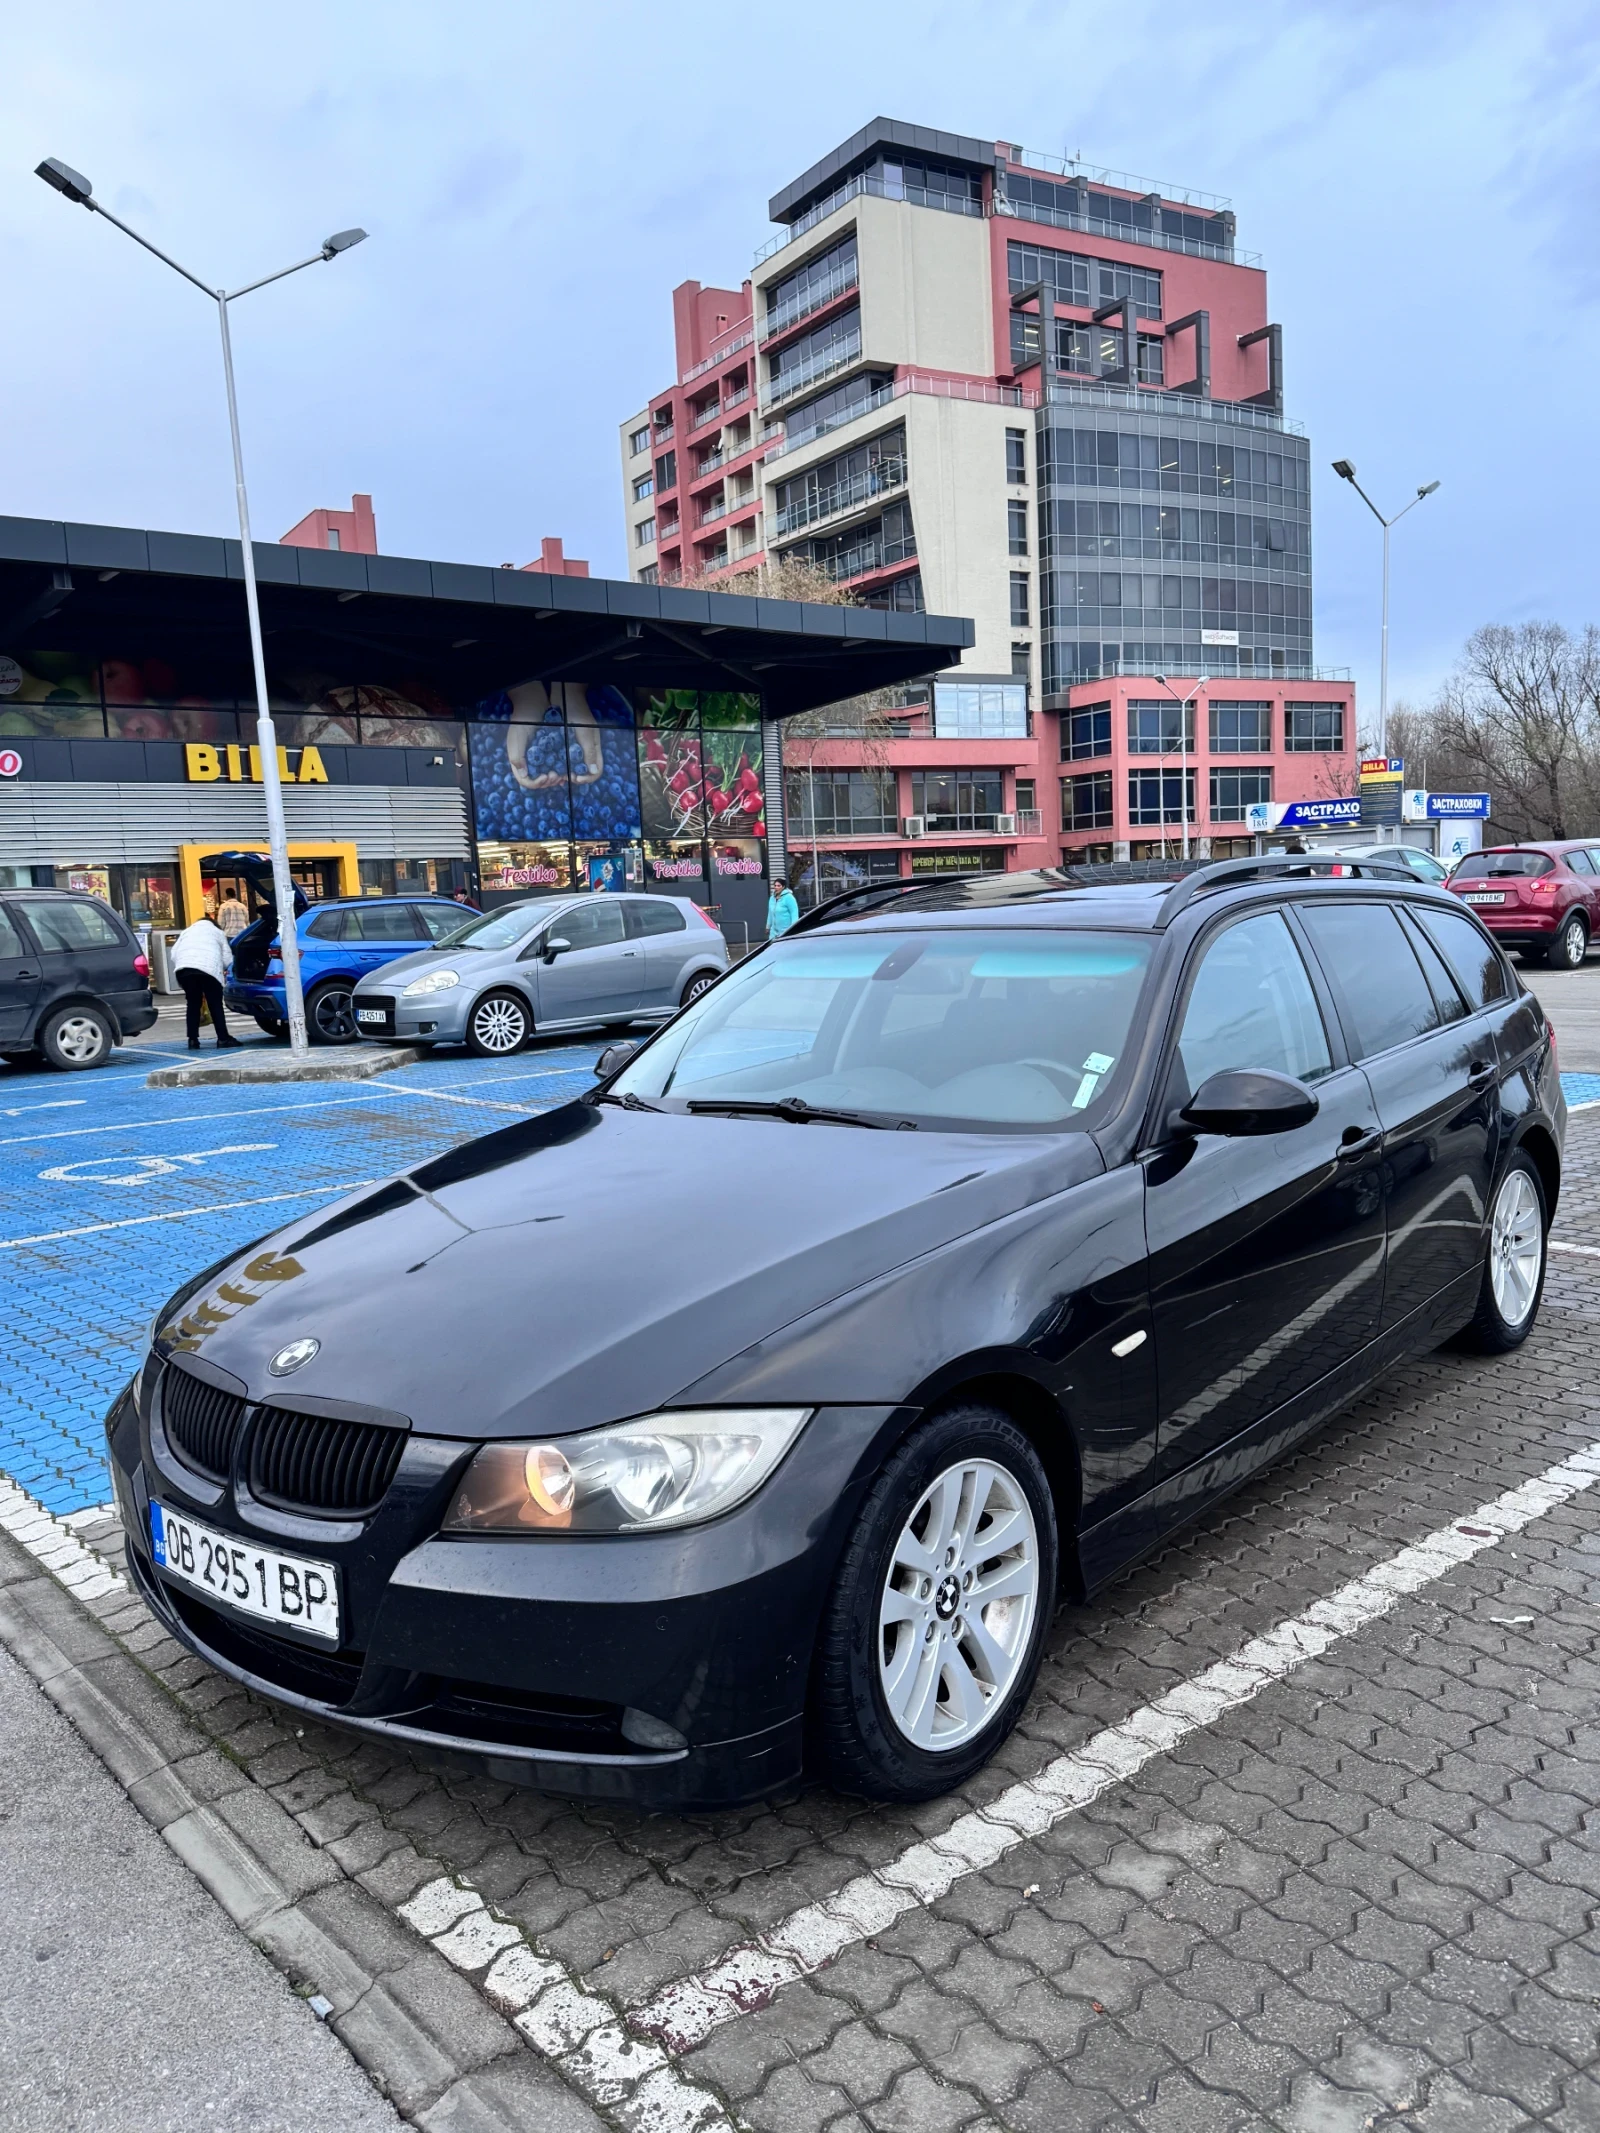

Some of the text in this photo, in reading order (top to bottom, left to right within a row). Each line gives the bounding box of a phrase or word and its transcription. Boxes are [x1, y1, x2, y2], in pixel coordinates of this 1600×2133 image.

[185, 743, 329, 783] BILLA
[1362, 762, 1386, 771] BILLA
[1295, 802, 1360, 817] ЗАСТРАХО
[1432, 798, 1483, 809] ЗАСТРАХОВКИ
[501, 863, 558, 884] Festiko
[653, 860, 702, 878] Festiko
[715, 857, 763, 875] Festiko
[156, 1539, 165, 1556] BG
[199, 1536, 268, 1608] 2951
